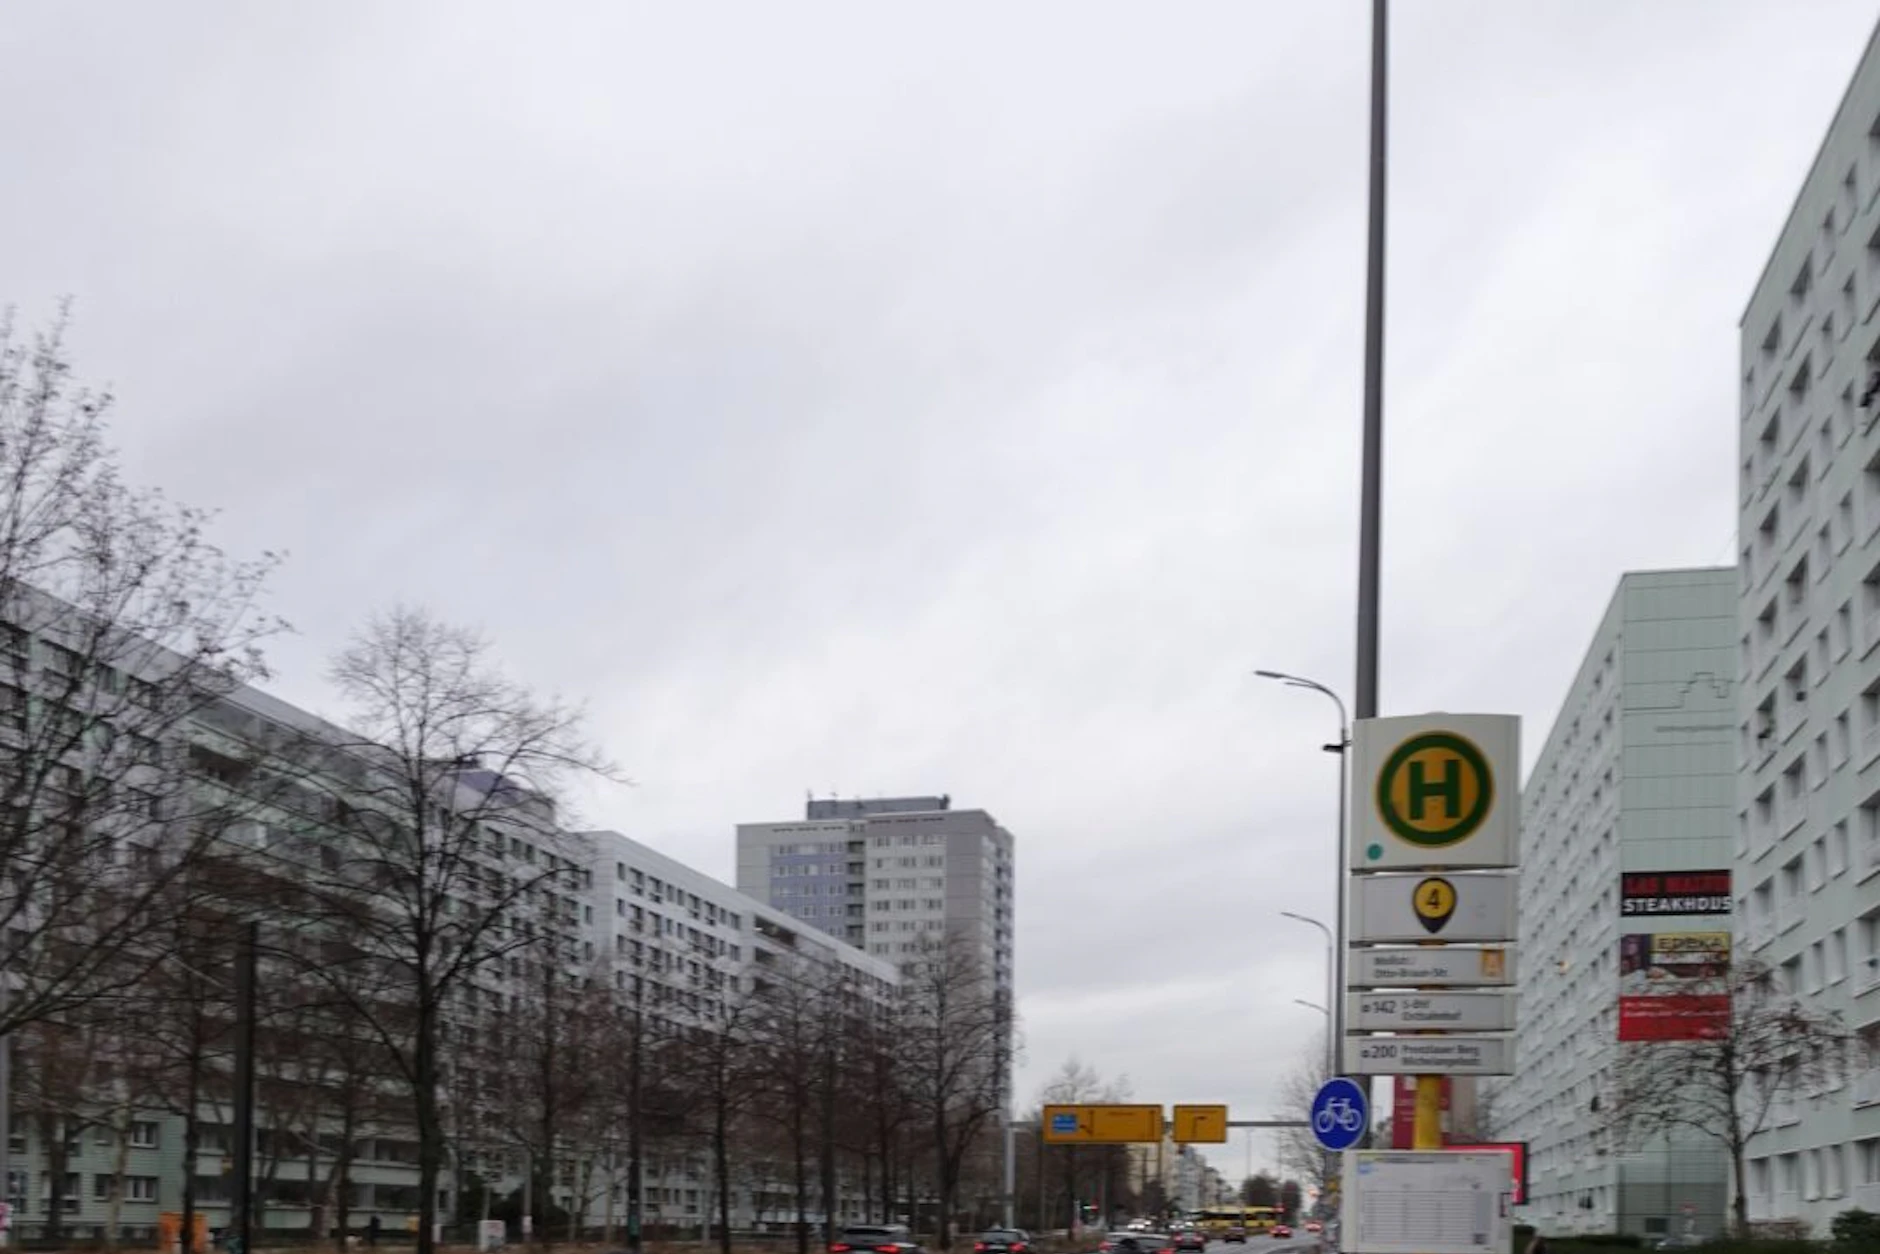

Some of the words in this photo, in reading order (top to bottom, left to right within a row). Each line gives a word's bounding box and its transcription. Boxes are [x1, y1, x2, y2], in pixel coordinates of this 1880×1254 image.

[1407, 759, 1461, 820] H
[1425, 888, 1439, 909] 4
[1659, 937, 1723, 951] EDEKA
[1371, 1045, 1397, 1058] 200
